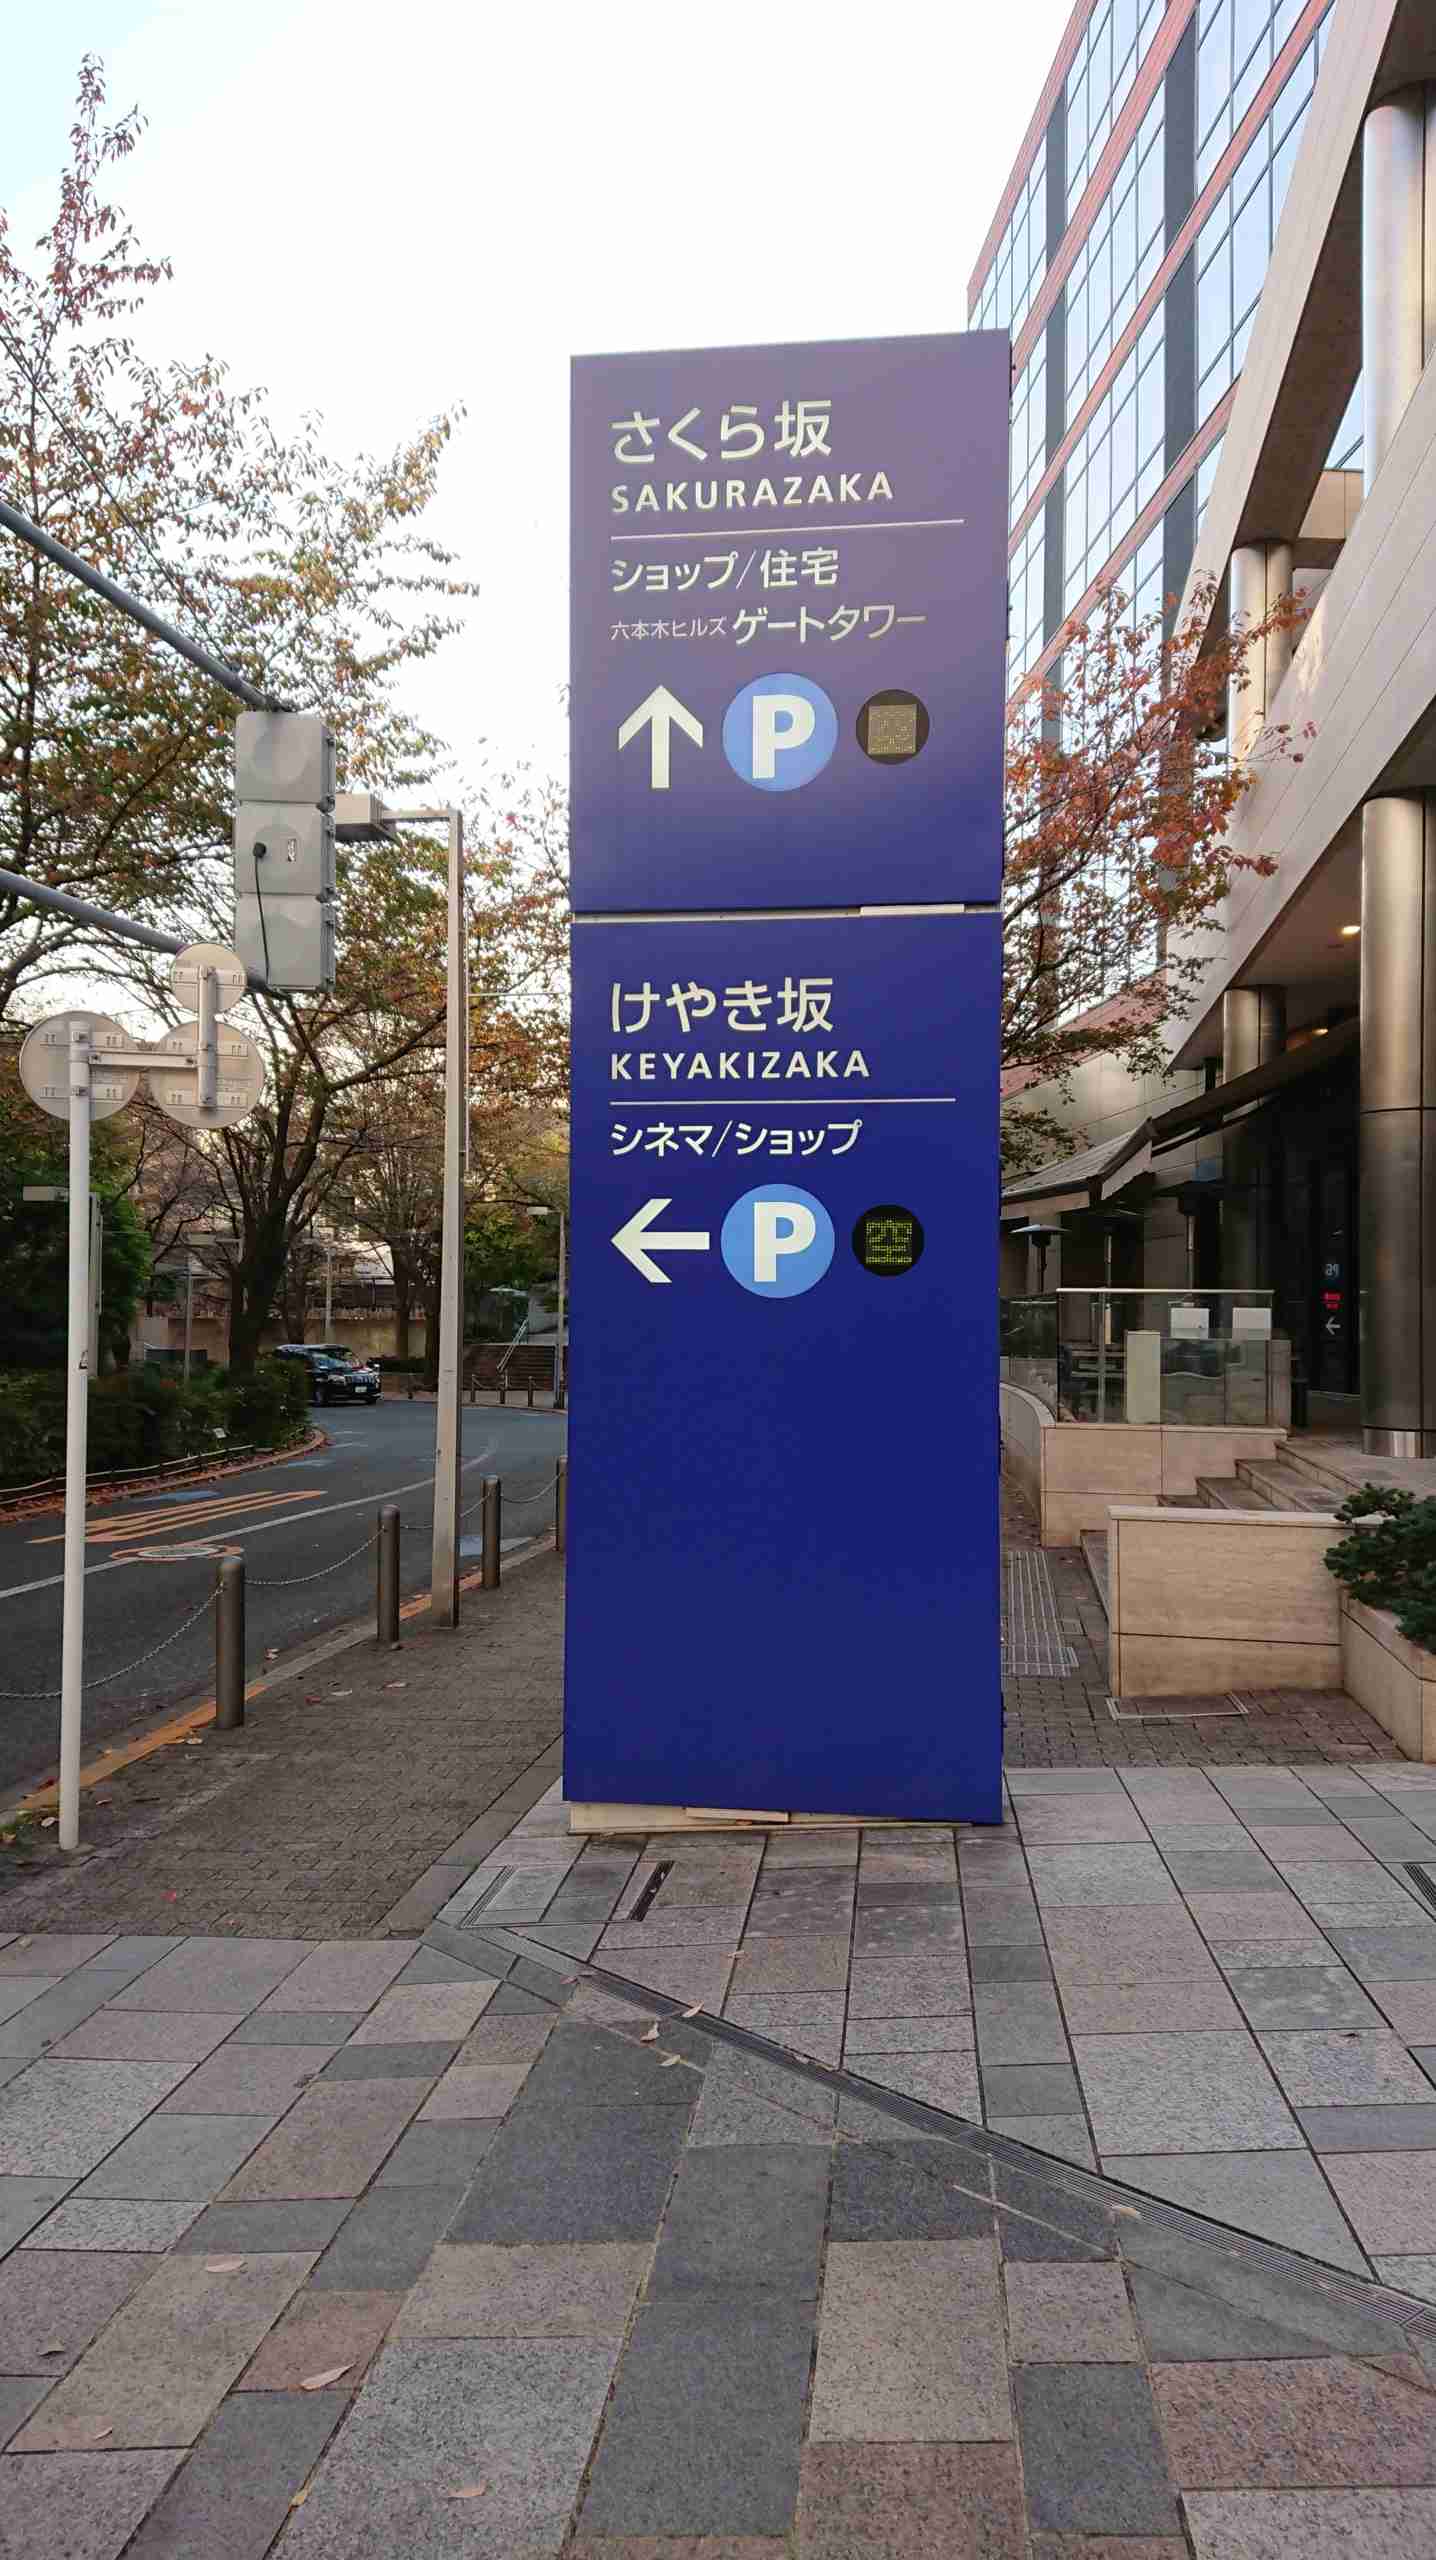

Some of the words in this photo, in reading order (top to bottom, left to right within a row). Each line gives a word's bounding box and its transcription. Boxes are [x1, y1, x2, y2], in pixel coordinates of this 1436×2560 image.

[612, 399, 832, 463] さくら坂
[611, 471, 893, 513] SAKURAZAKA
[752, 695, 815, 779] P
[612, 977, 833, 1033] けやき坂
[611, 1050, 870, 1080] KEYAKIZAKA
[753, 1202, 816, 1282] P
